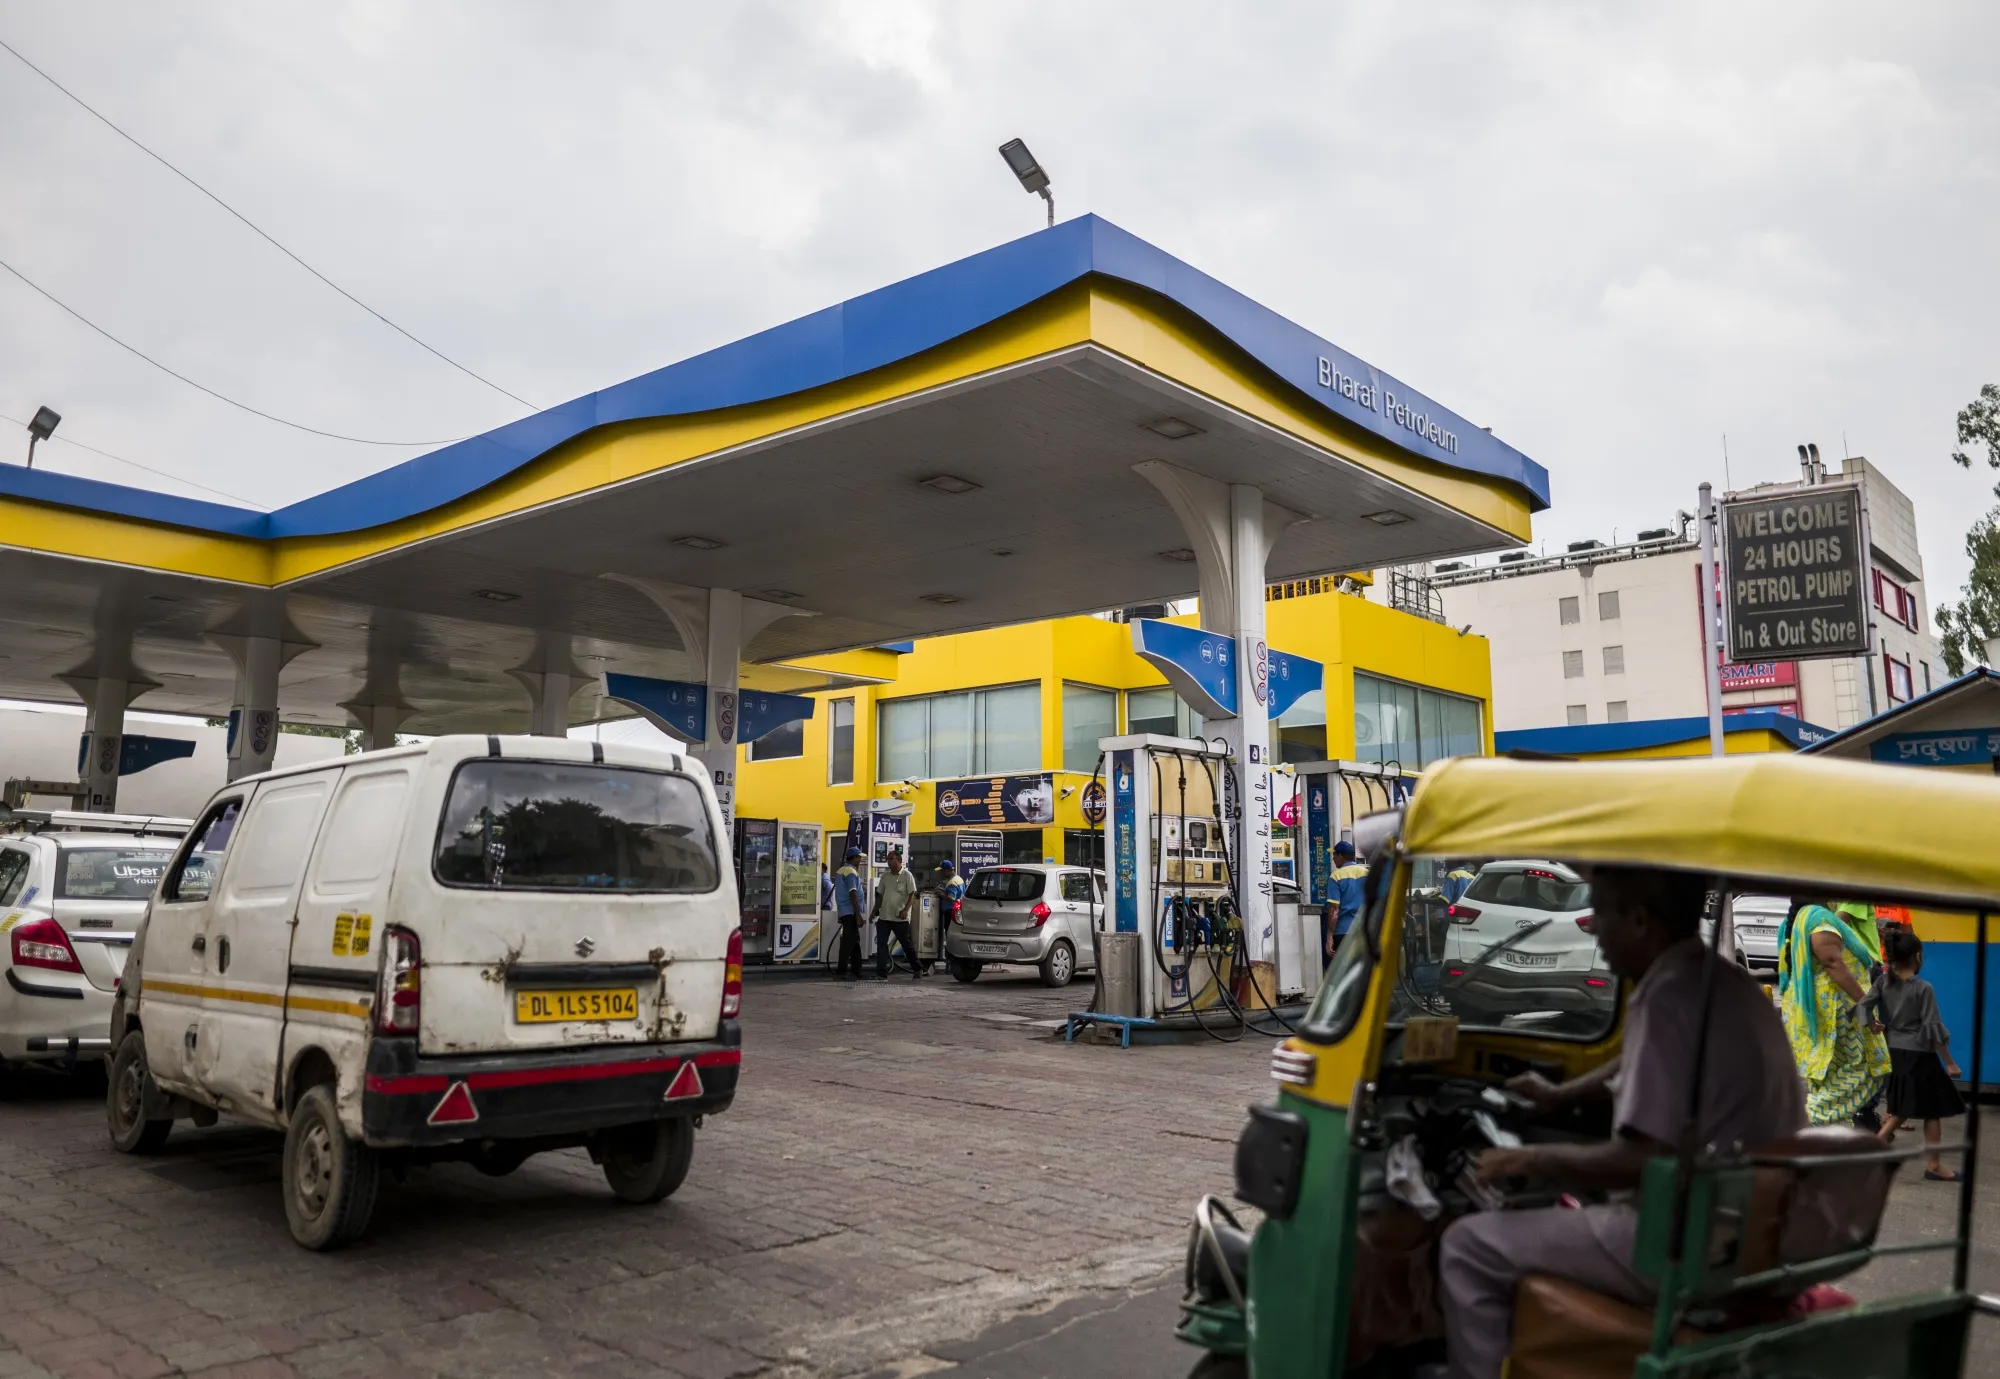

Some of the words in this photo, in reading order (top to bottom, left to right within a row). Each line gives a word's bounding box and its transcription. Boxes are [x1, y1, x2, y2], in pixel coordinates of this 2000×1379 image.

[1317, 356, 1377, 412] Bharat
[1384, 391, 1457, 455] Petroleum
[1733, 501, 1849, 539] WELCOME
[1744, 546, 1766, 571] 24
[1773, 536, 1841, 568] HOURS
[1736, 575, 1800, 605] PETROL
[1805, 570, 1853, 599] PUMP
[1739, 624, 1754, 649] In
[1759, 622, 1771, 647] &
[1777, 619, 1806, 646] Out
[1811, 617, 1857, 644] Store
[1721, 662, 1777, 680] SMART
[1220, 678, 1225, 695] 1
[1268, 689, 1276, 706] 3
[687, 715, 695, 730] 5
[745, 721, 752, 734] 7
[1254, 771, 1267, 790] kar
[1254, 795, 1269, 818] feel
[875, 821, 897, 833] ATM
[1260, 842, 1272, 875] future
[113, 866, 158, 877] Uber
